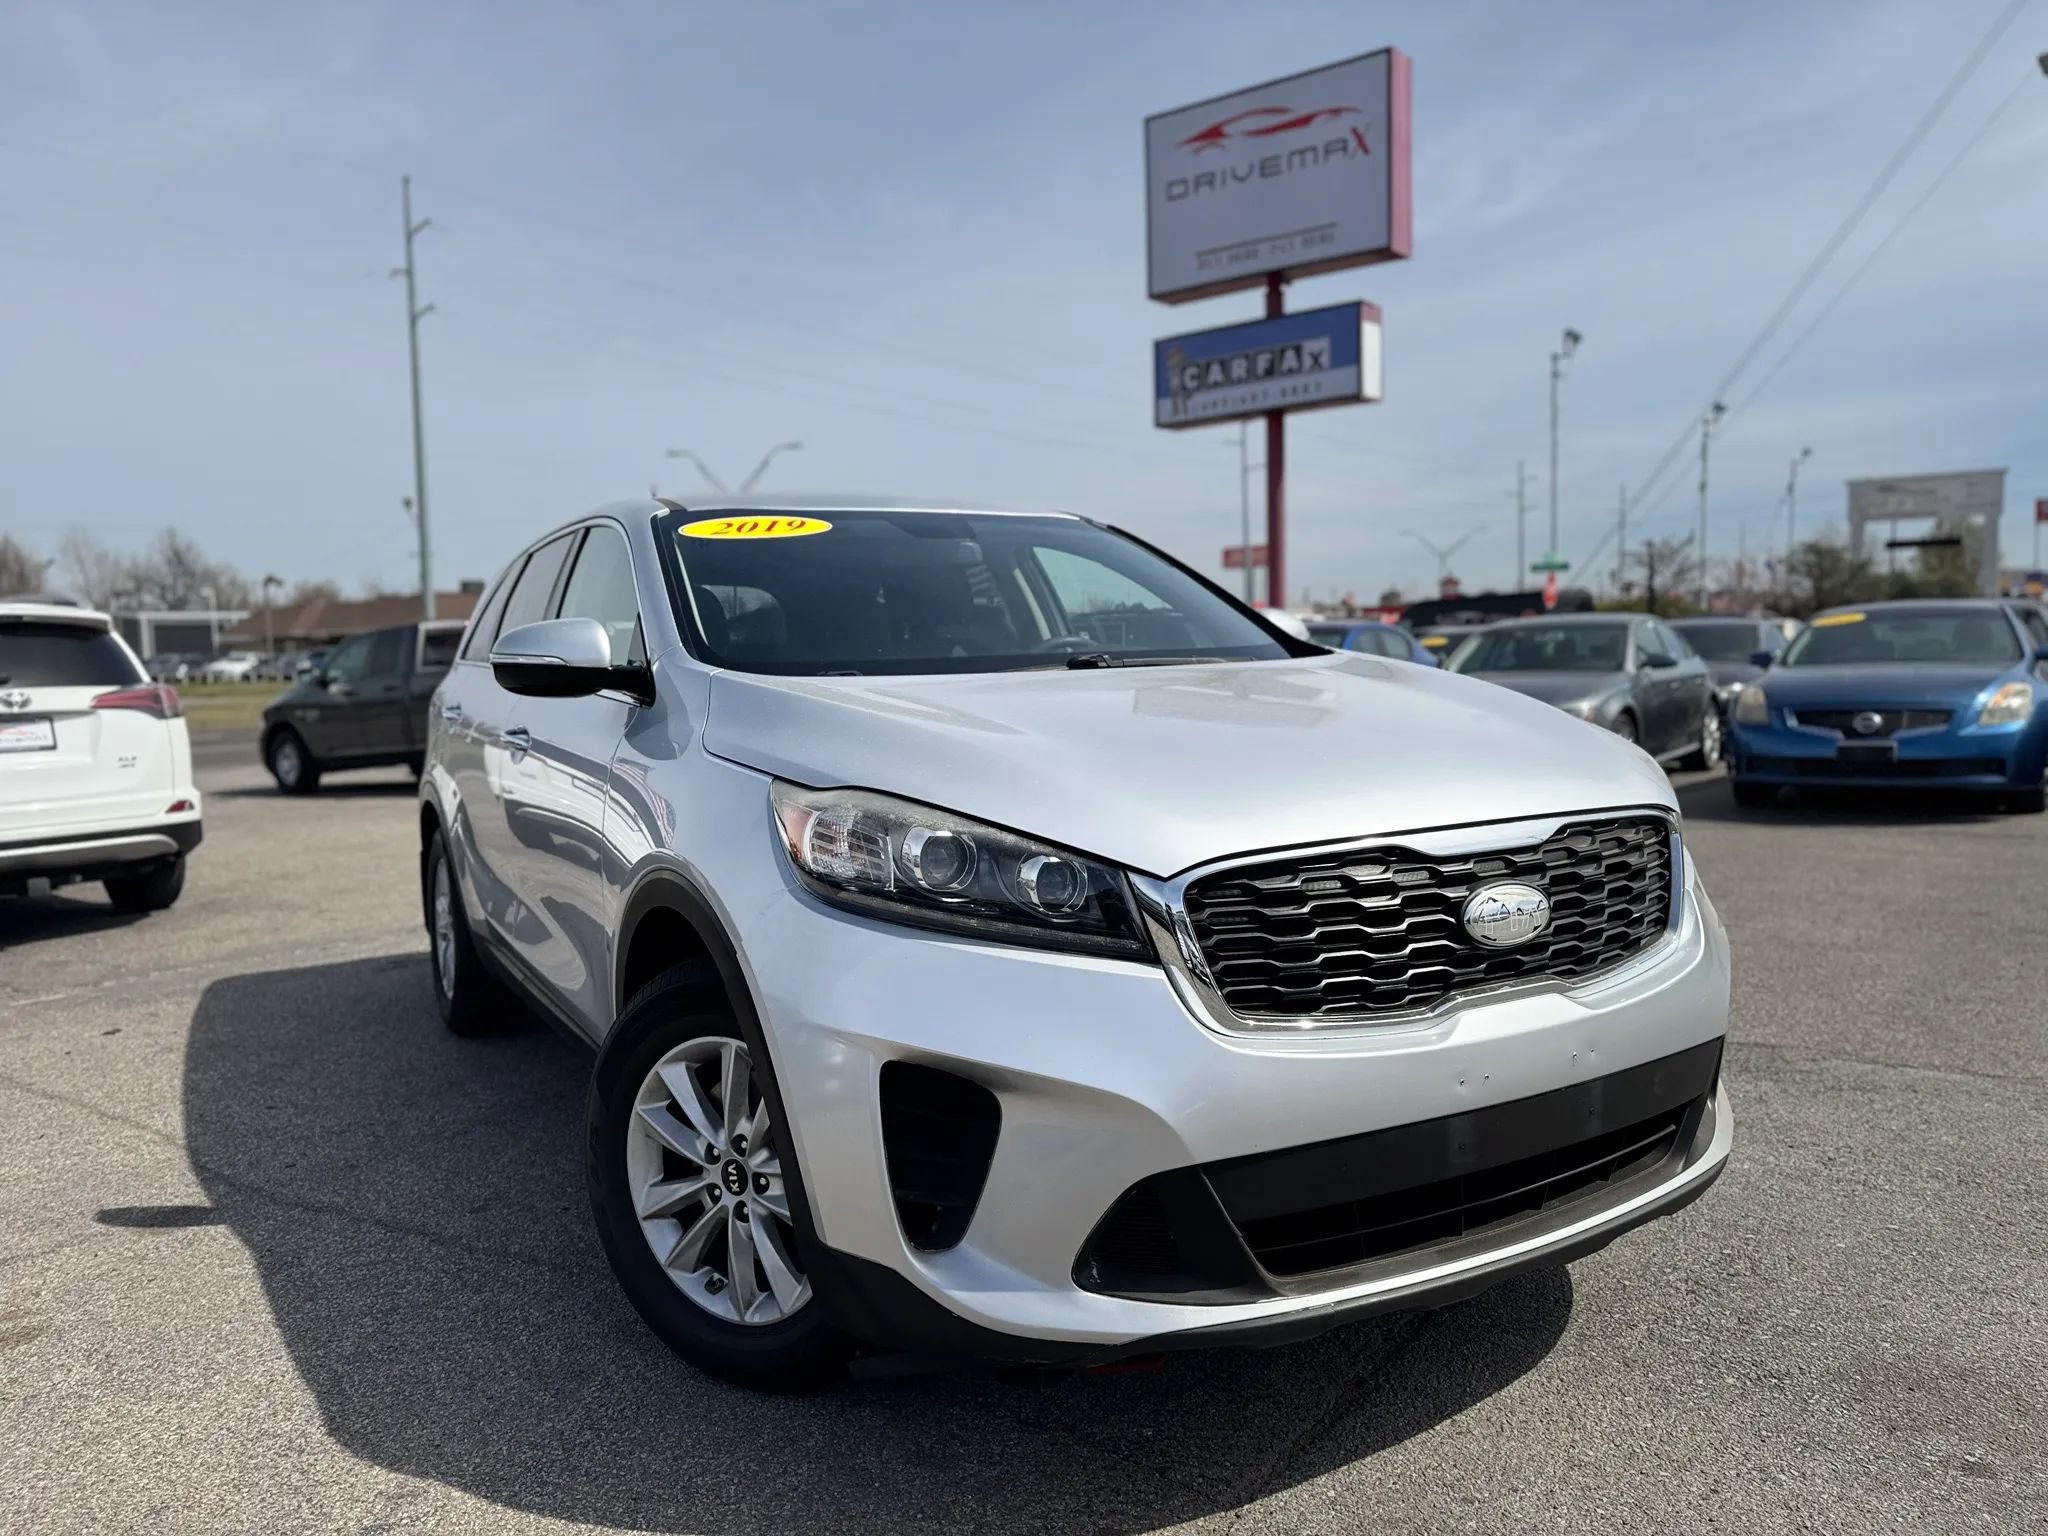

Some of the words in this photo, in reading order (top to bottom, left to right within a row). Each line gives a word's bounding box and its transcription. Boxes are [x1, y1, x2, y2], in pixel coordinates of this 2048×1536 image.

[1166, 123, 1371, 202] DRIVEMAX
[1183, 348, 1326, 389] CARFAX
[710, 519, 807, 535] 2019
[727, 1163, 740, 1192] KIA
